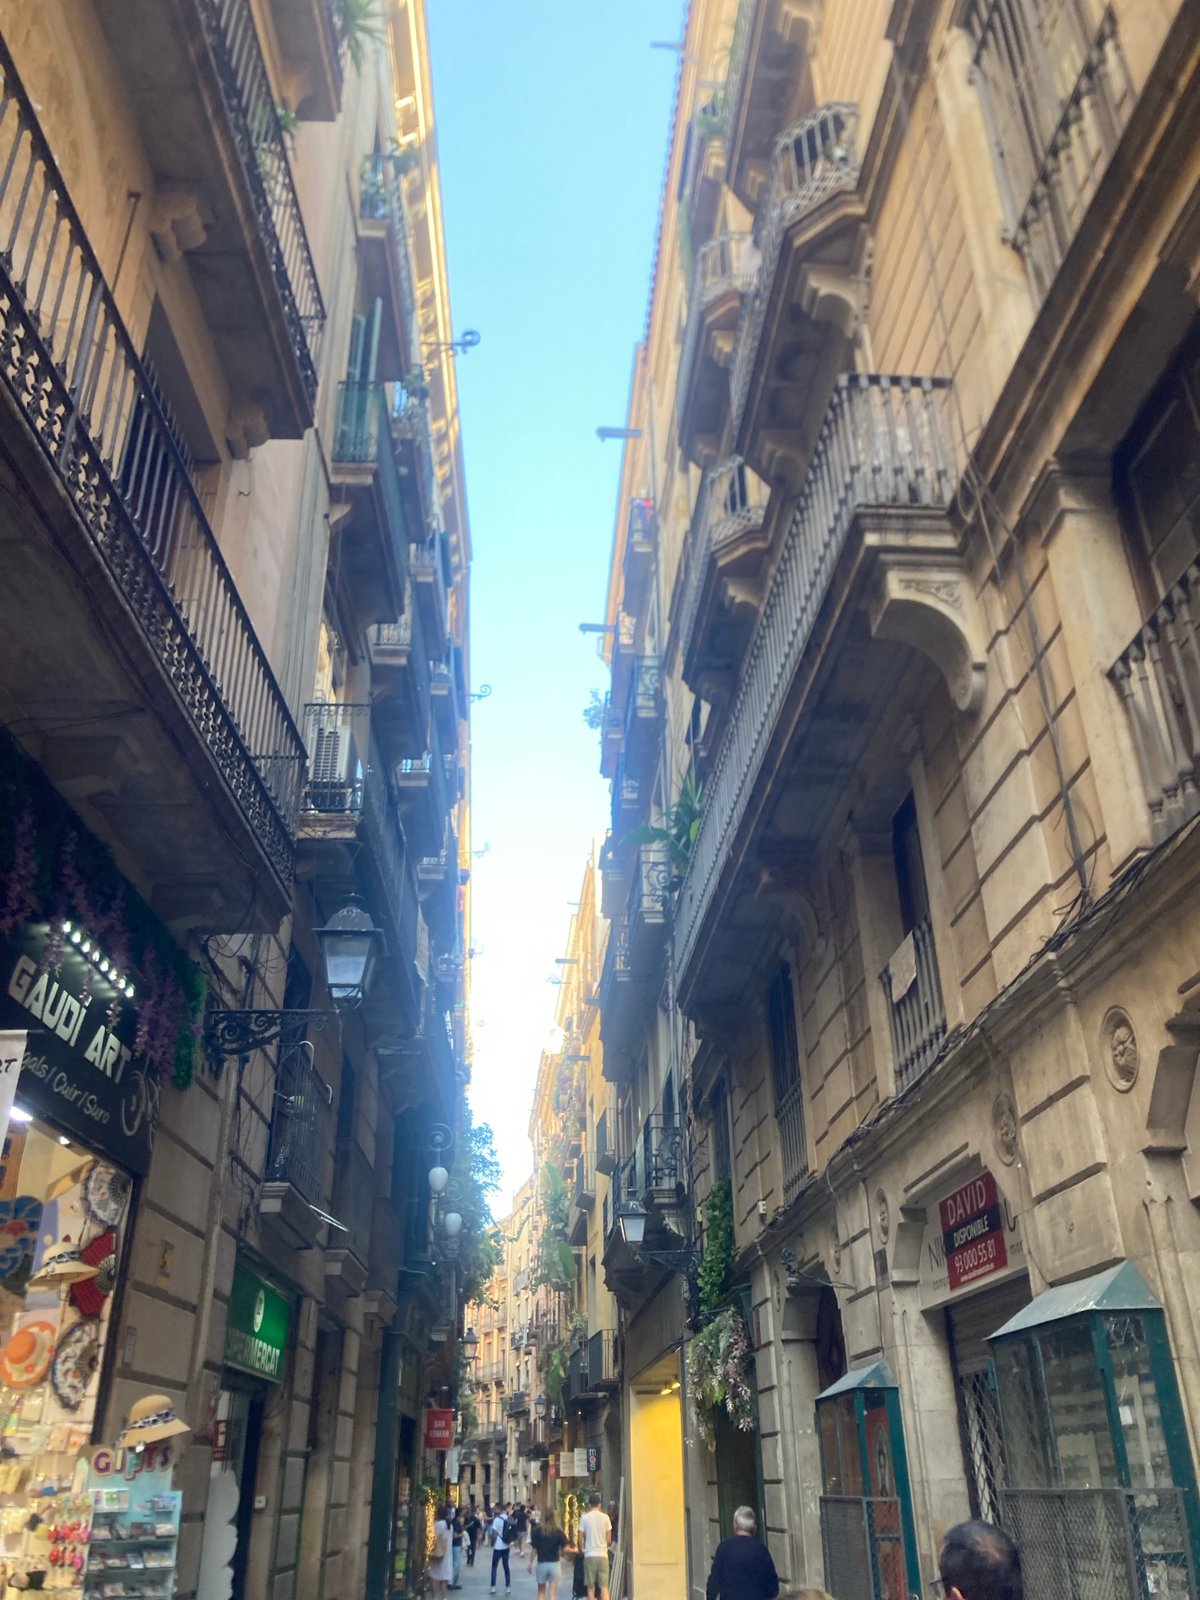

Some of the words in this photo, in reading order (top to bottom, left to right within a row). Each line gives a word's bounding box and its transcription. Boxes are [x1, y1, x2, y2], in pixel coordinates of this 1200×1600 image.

[84, 1024, 132, 1084] ART
[947, 1180, 987, 1226] DAVID
[953, 1214, 990, 1248] DISPONIBLE
[954, 1254, 964, 1274] 93
[963, 1247, 978, 1270] 000
[978, 1242, 988, 1263] 55
[987, 1238, 997, 1259] 81
[93, 1445, 171, 1479] GIFTS
